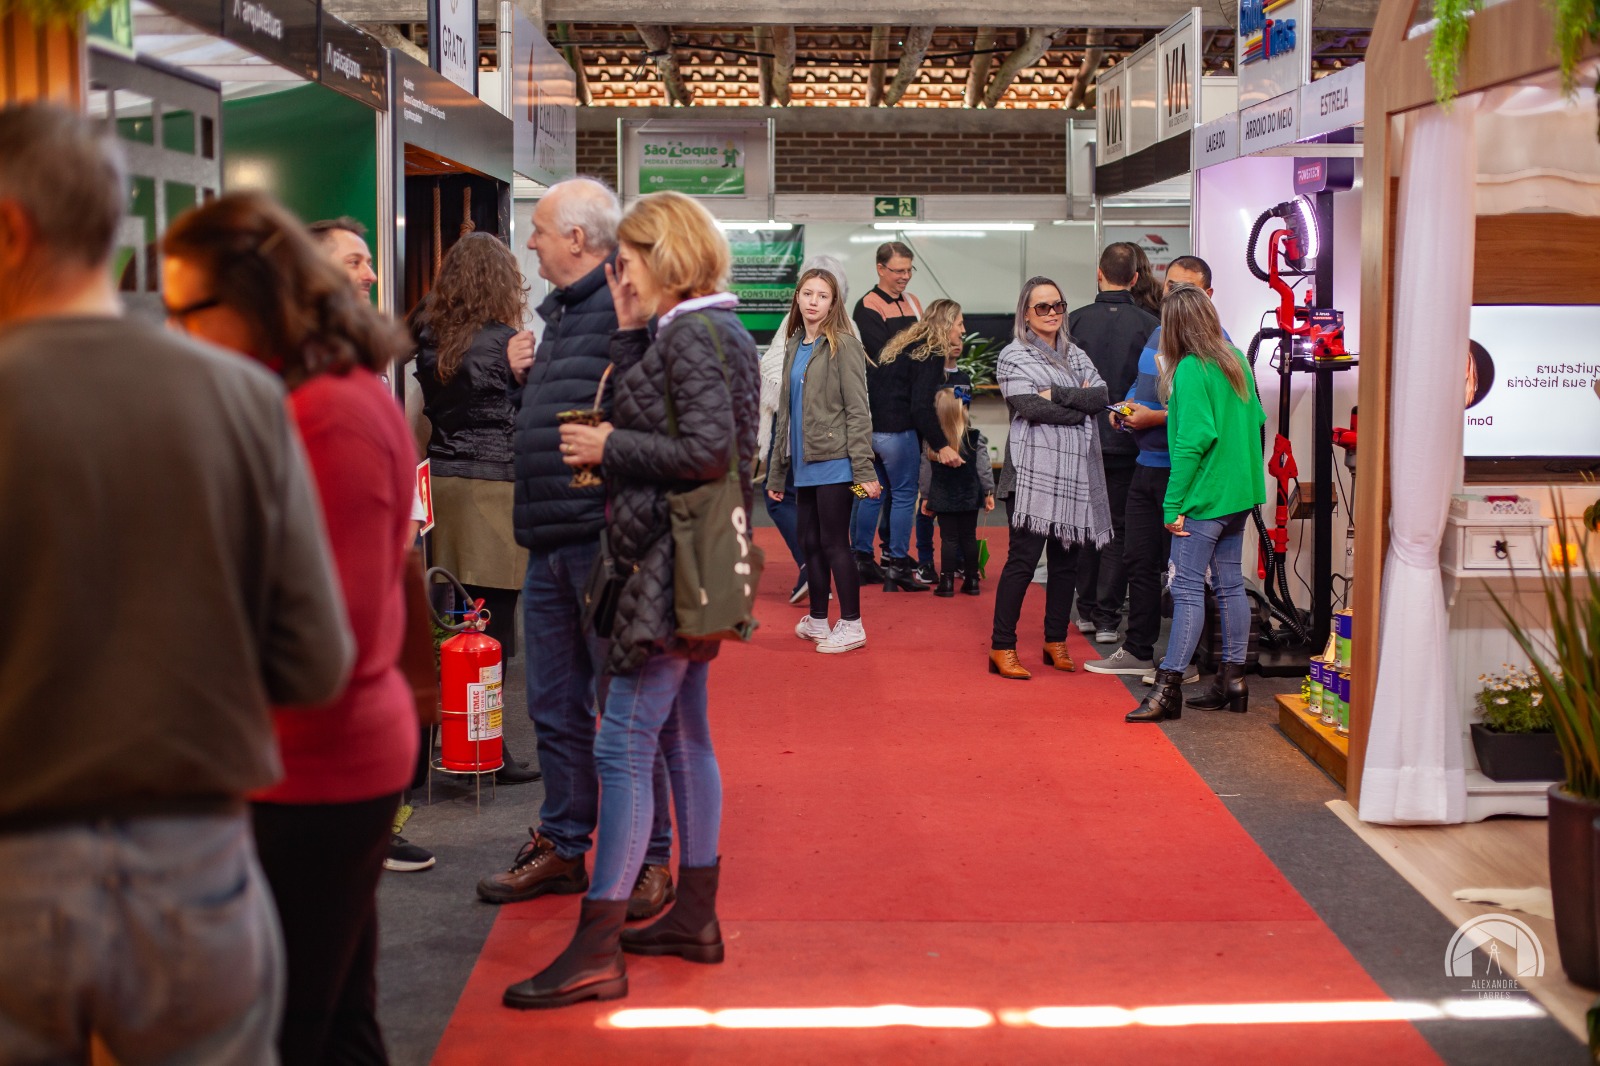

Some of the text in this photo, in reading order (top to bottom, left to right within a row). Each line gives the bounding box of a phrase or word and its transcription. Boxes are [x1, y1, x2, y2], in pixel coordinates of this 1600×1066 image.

[242, 1, 284, 40] arquitetura
[333, 48, 361, 80] paisagismo
[442, 24, 467, 71] GRATTA
[1166, 43, 1189, 117] VIA
[1104, 86, 1122, 147] VIA
[1320, 86, 1349, 117] ESTRELA
[1245, 106, 1293, 140] ARROIO DO MEIO
[644, 144, 667, 156] São
[1205, 130, 1226, 153] LAJEADO
[675, 157, 718, 166] CONSTRUÇÃO
